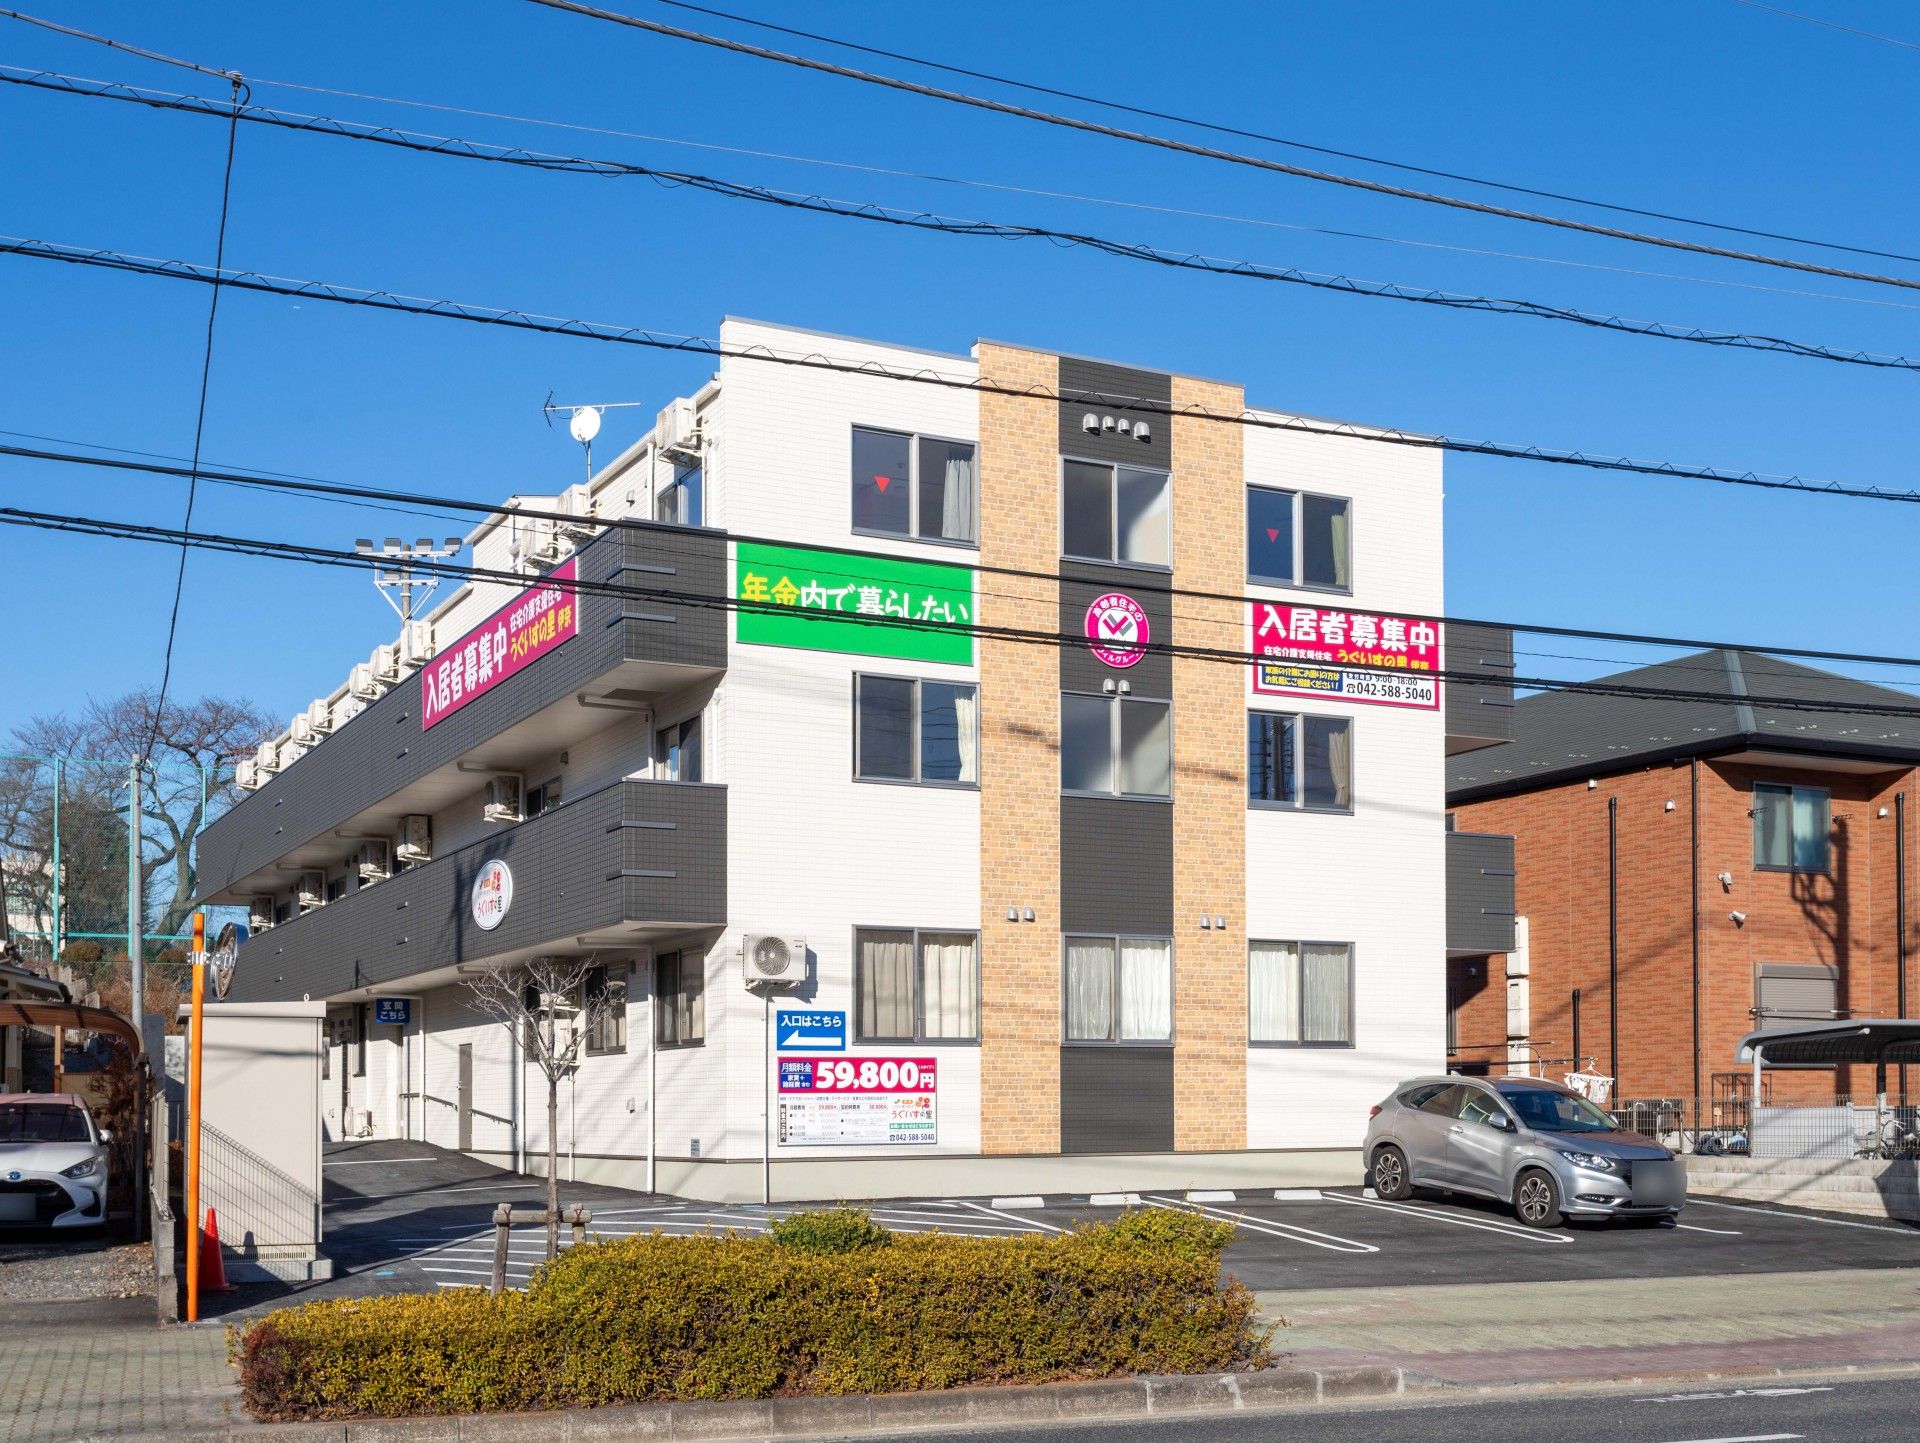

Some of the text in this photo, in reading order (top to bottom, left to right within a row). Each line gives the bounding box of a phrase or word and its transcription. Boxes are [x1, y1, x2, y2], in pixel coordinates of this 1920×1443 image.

[740, 572, 969, 624] 年金内で暮らしたい
[1258, 604, 1435, 655] 入居者募集中
[1337, 649, 1407, 668] うぐいすの里
[426, 621, 507, 720] 入居者募集中
[1357, 682, 1432, 701] 042-588-5040
[380, 1011, 406, 1020] こちら
[781, 1014, 842, 1028] 入口はこちら
[781, 1062, 812, 1073] 月額料金
[895, 1133, 935, 1141] 042-588-5040
